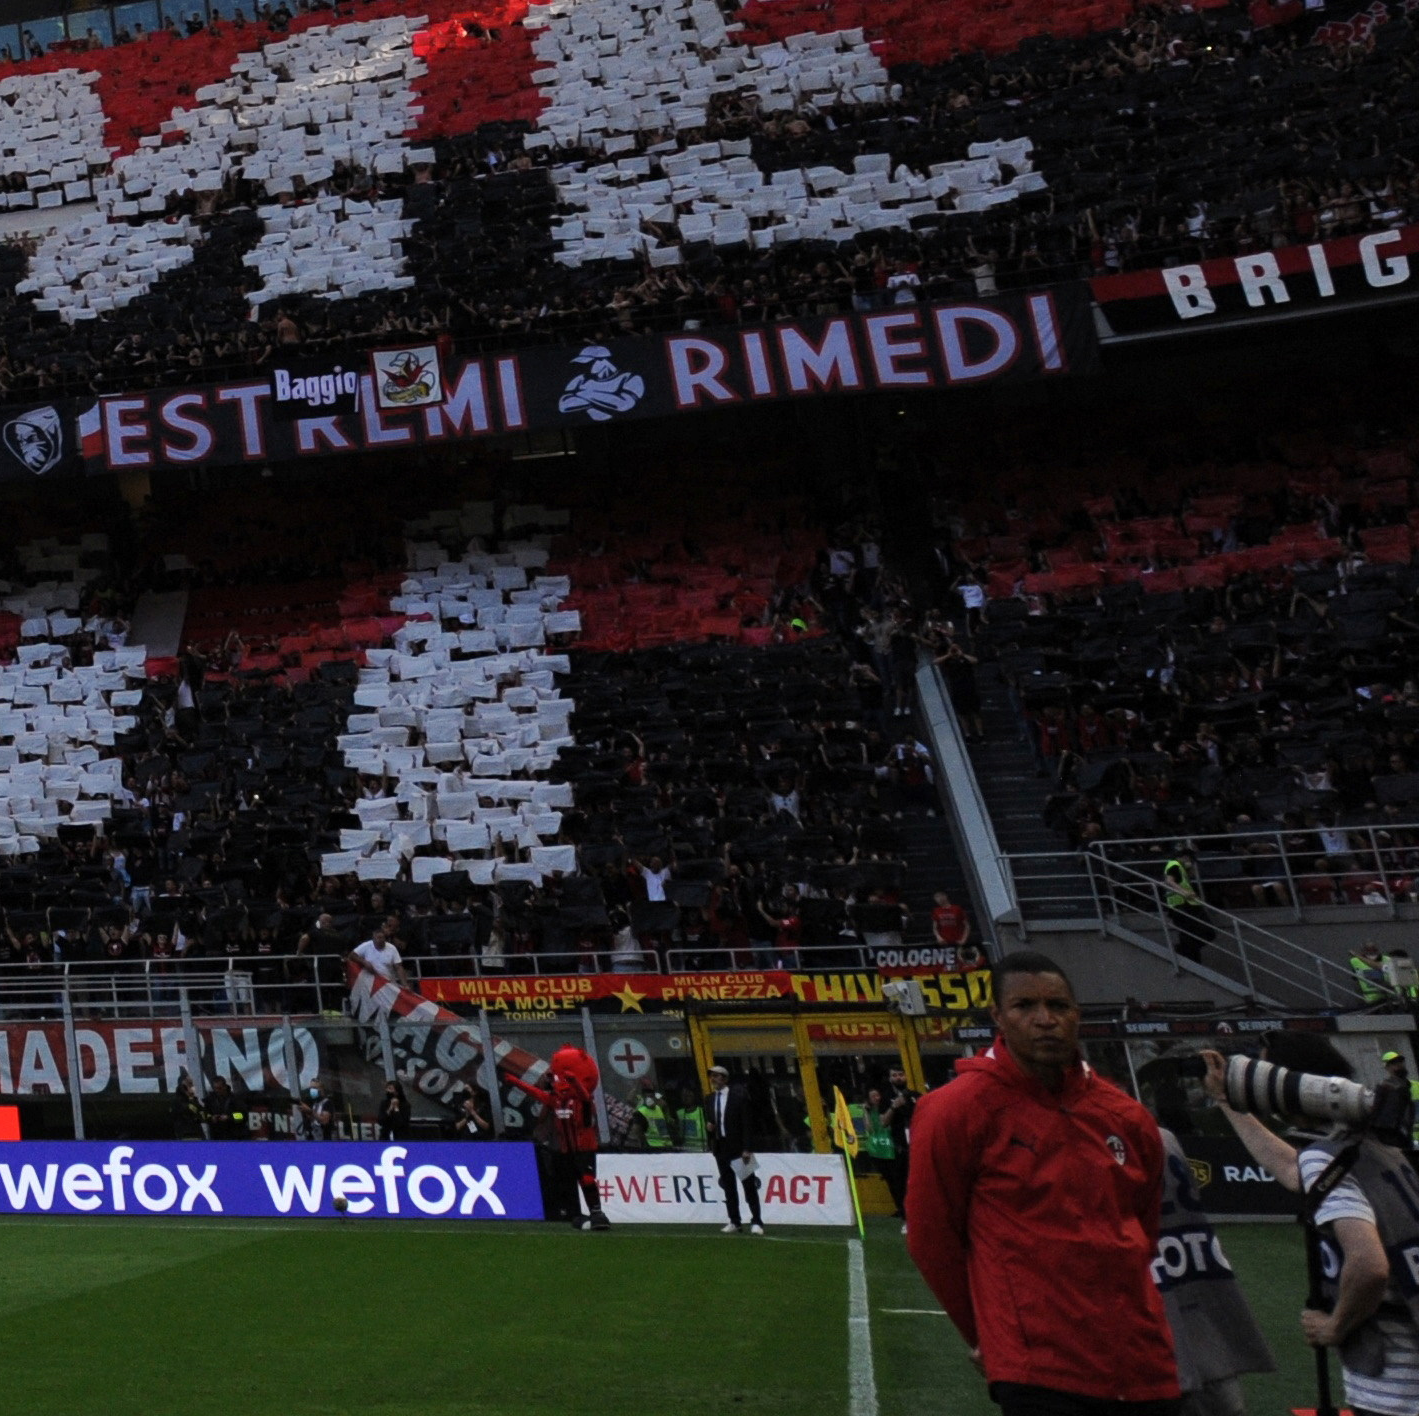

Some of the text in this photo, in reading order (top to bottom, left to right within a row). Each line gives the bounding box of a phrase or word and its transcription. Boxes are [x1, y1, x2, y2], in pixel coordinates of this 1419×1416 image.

[665, 291, 1068, 408] RIMEDI
[876, 948, 956, 968] COLOGNE
[459, 978, 593, 996] MILAN CLUB
[674, 973, 766, 987] MILAN CLUB
[662, 984, 782, 1002] PIANEZZA
[504, 1011, 557, 1022] TORINO
[260, 1145, 507, 1216] wefox
